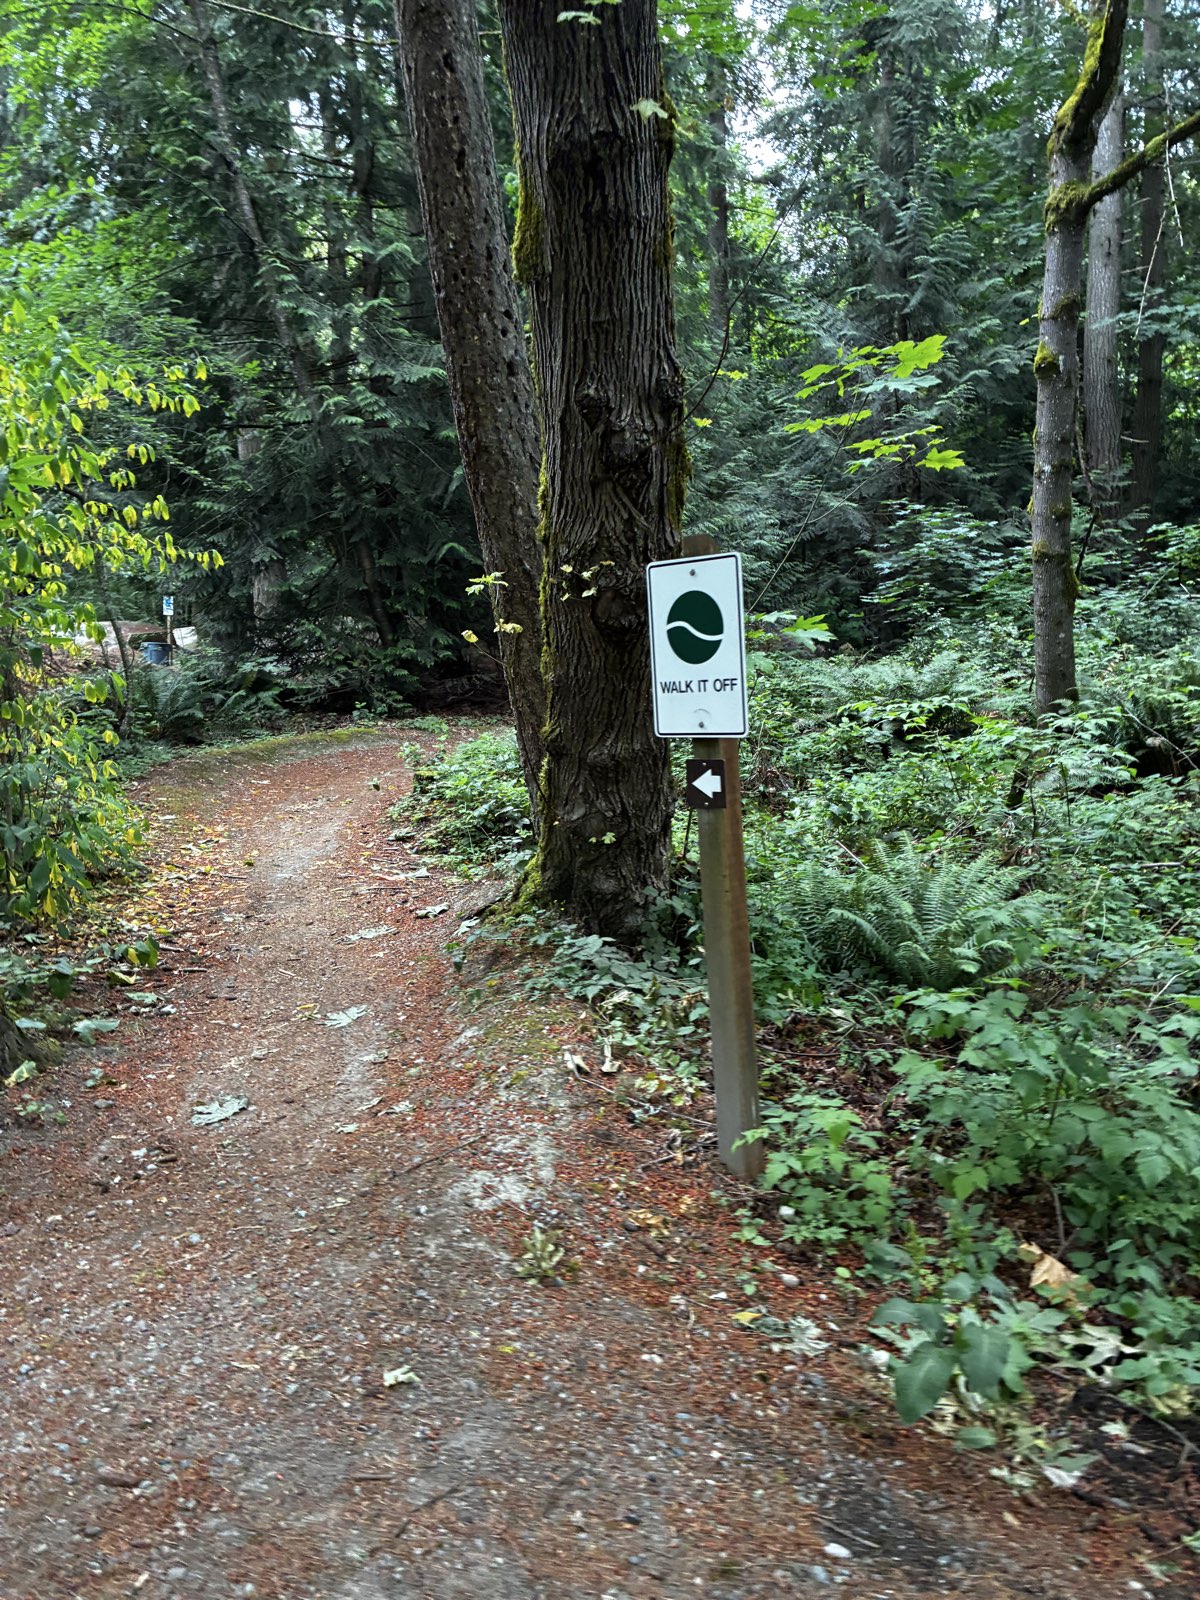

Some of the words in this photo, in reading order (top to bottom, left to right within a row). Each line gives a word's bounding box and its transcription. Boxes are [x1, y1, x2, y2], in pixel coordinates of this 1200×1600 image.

[660, 680, 694, 694] WALK
[698, 679, 709, 692] IT
[713, 678, 738, 692] OFF
